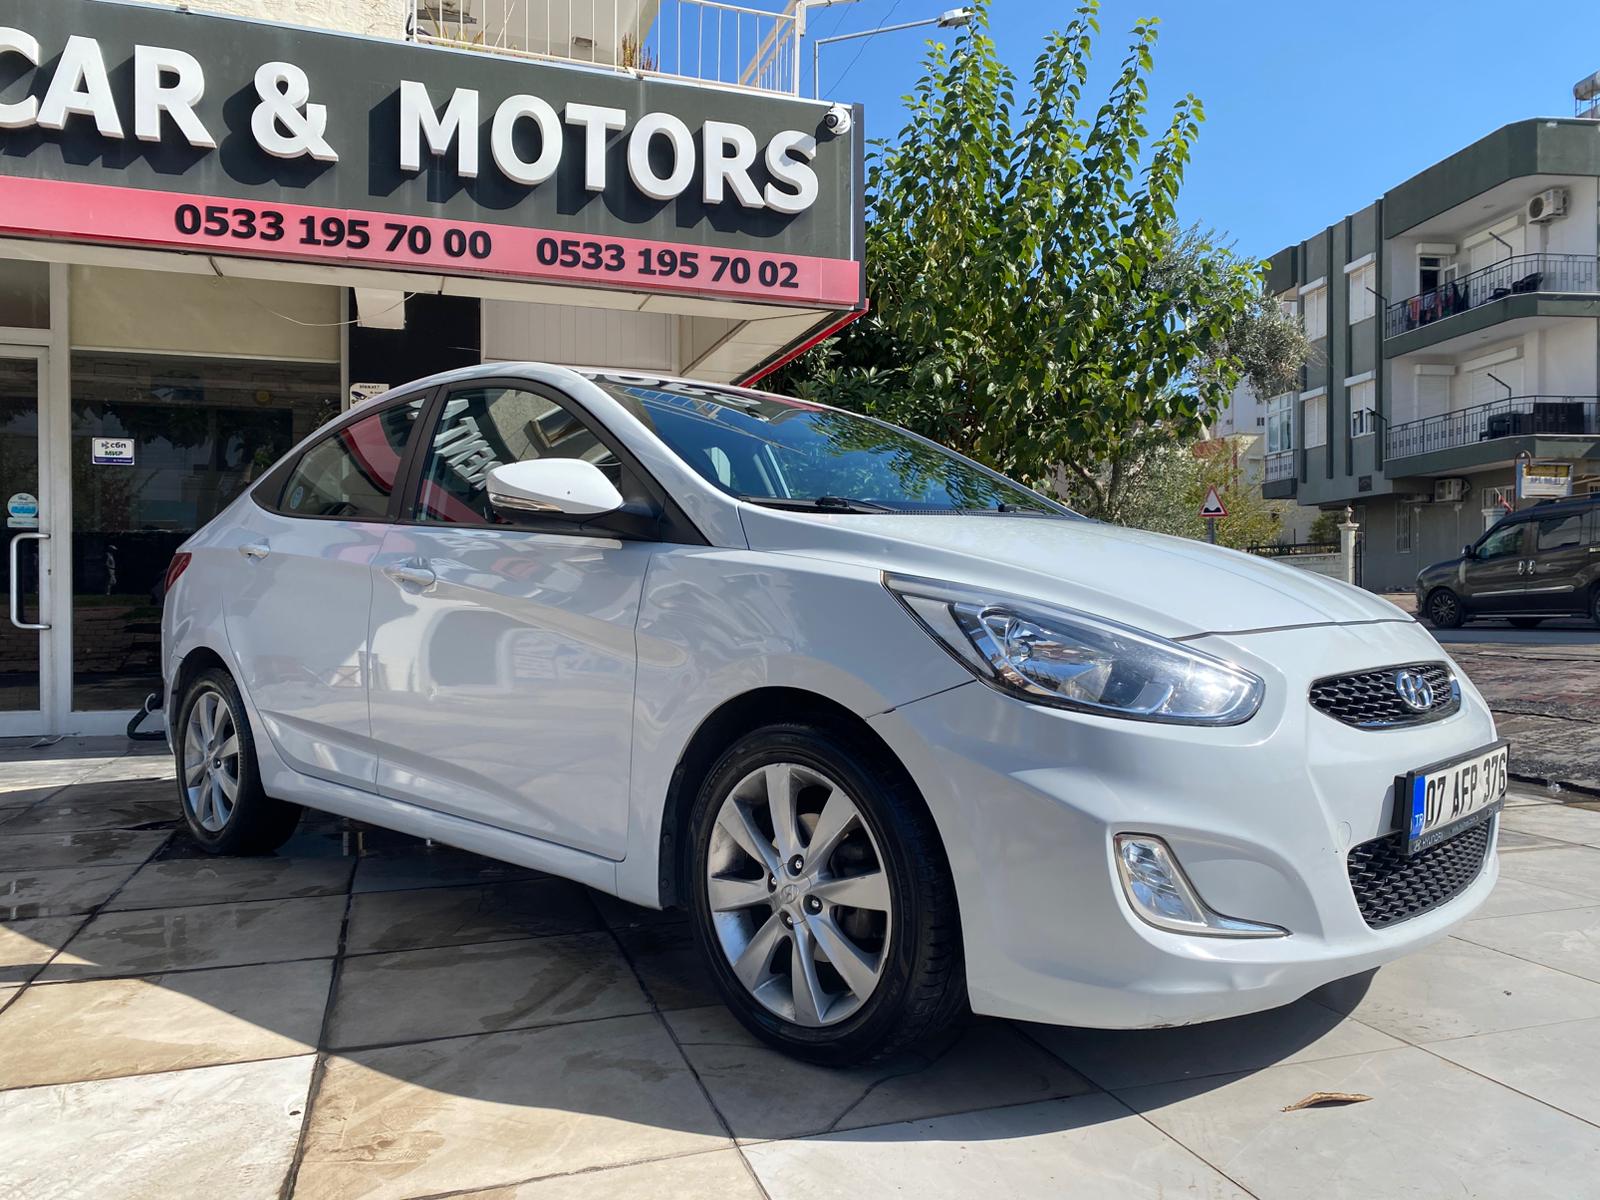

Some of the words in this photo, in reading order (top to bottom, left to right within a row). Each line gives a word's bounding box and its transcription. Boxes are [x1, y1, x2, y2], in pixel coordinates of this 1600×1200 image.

[251, 62, 339, 162] &
[400, 80, 819, 214] MOTORS
[174, 204, 285, 241] 0533
[299, 215, 370, 249] 195
[384, 223, 432, 254] 70
[443, 228, 493, 259] 00
[536, 237, 625, 272] 0533
[638, 248, 699, 279] 195
[710, 256, 751, 284] 70
[758, 260, 799, 289] 02
[1425, 776, 1446, 829] 07
[1450, 764, 1477, 818] AFP
[1483, 752, 1506, 802] 376
